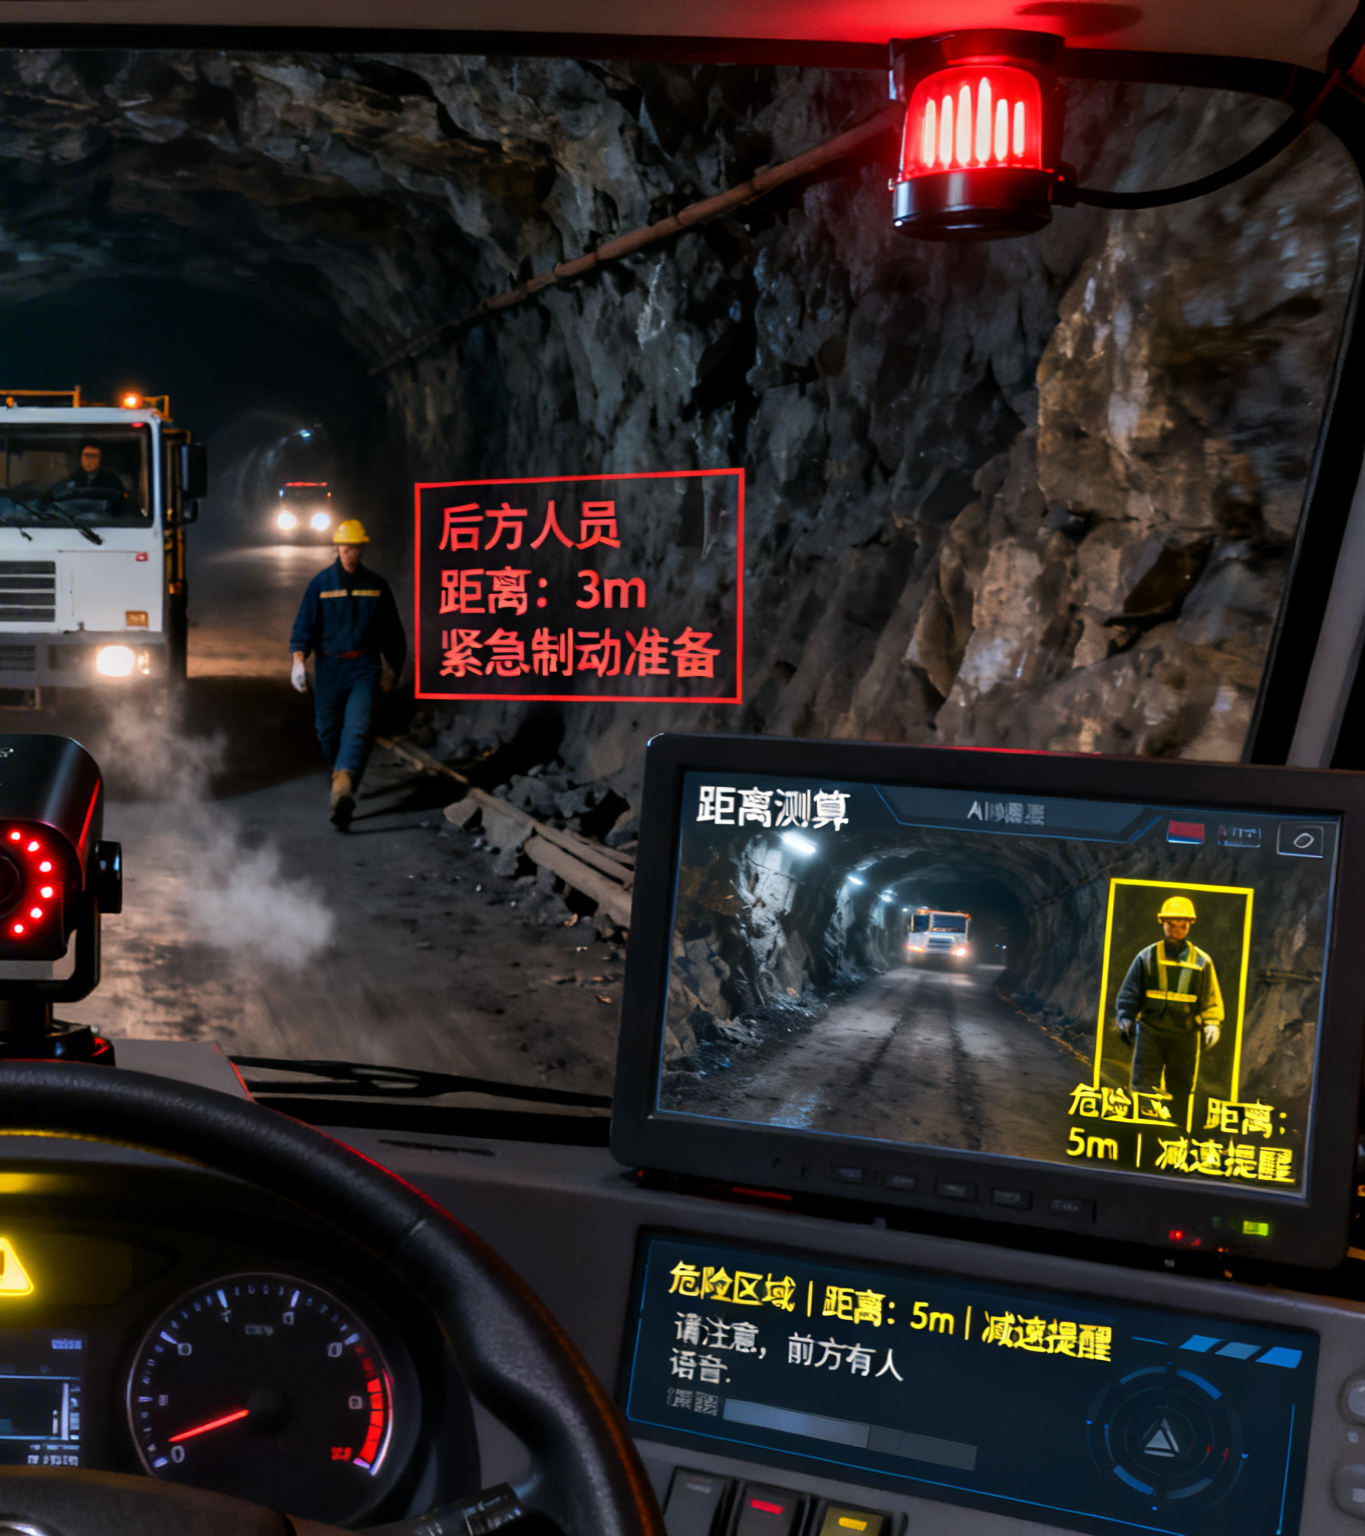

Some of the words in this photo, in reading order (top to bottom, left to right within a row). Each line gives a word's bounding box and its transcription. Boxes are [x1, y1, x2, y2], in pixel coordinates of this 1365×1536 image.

[696, 785, 851, 832] 距离测算
[1066, 1126, 1118, 1161] 5m
[669, 1261, 796, 1312] 危险区域
